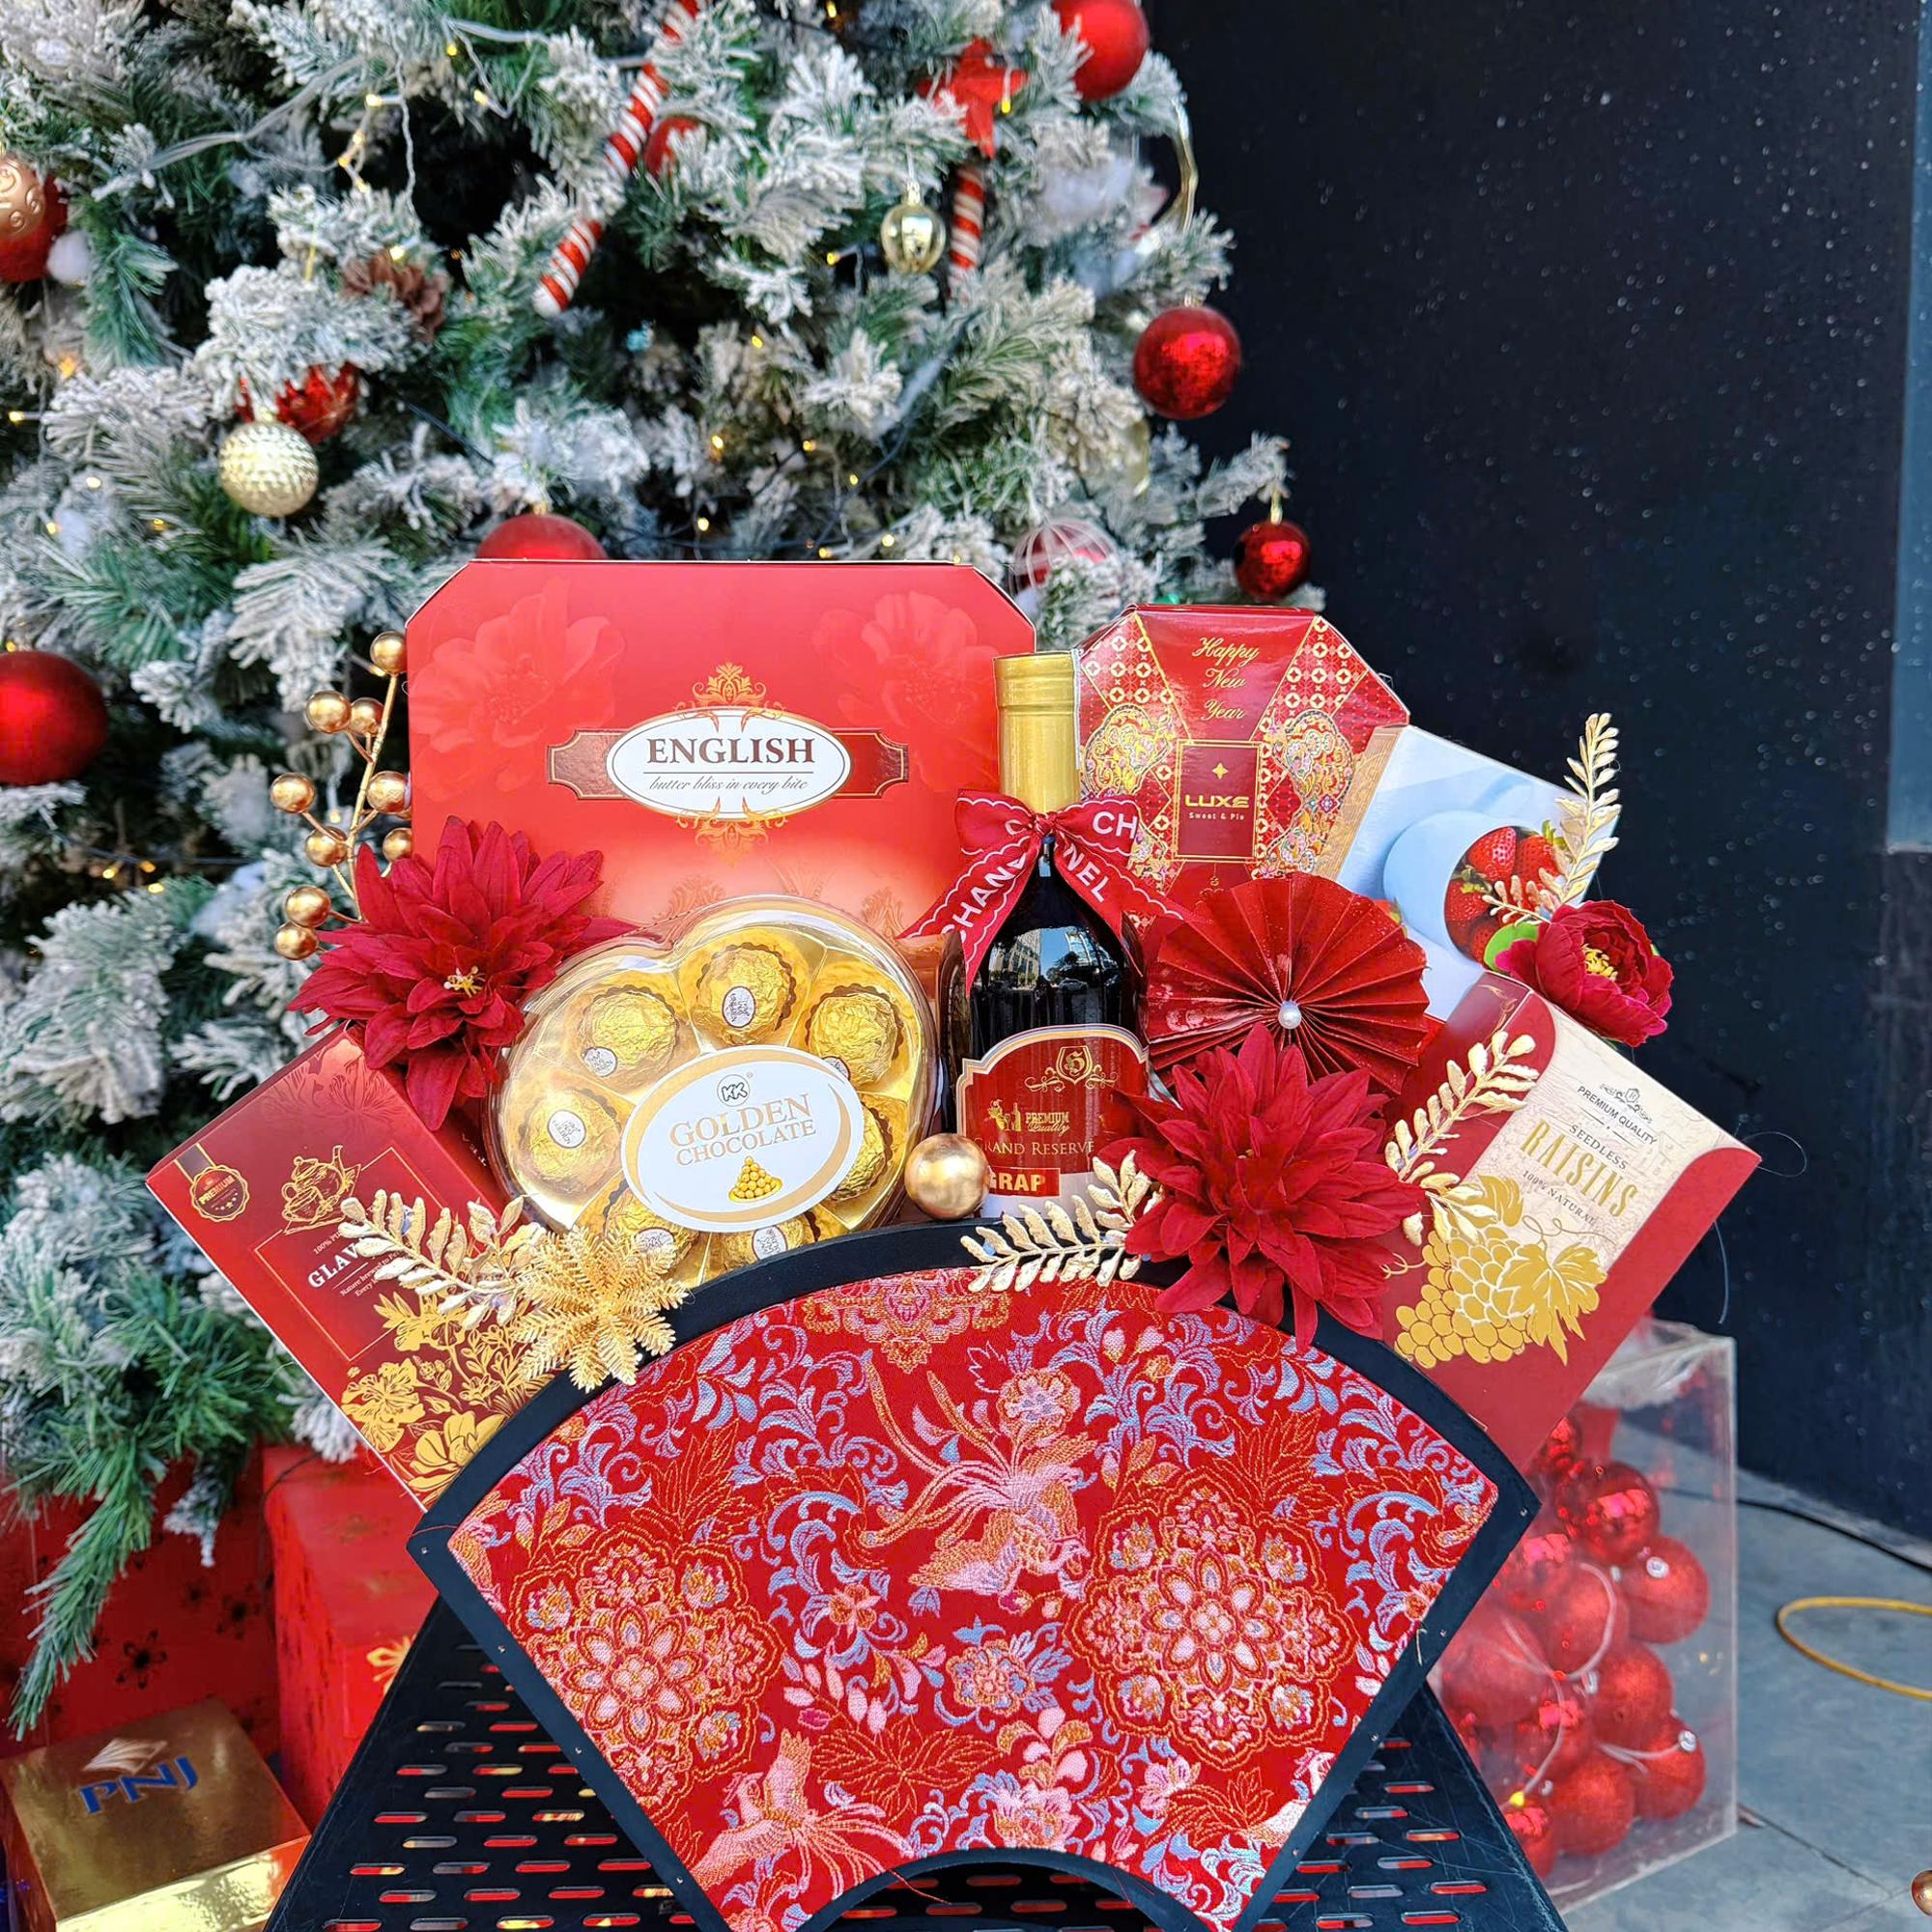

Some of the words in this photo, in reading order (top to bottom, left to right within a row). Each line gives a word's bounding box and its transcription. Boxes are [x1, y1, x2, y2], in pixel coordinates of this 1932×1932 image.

[1192, 638, 1260, 667] Happy
[1203, 668, 1246, 689] New
[1201, 699, 1246, 721] Year
[646, 738, 816, 764] ENGLISH
[649, 776, 691, 790] butter
[693, 776, 724, 790] bliss
[725, 778, 741, 790] in
[743, 780, 779, 796] every
[781, 775, 809, 790] bite
[1184, 794, 1249, 809] LUXE
[721, 1081, 748, 1102] KK
[669, 1094, 812, 1148] GOLDEN
[1025, 1112, 1069, 1123] PREMIUM
[1028, 1121, 1070, 1137] Quality
[1577, 1085, 1619, 1120] PREMIUM
[1618, 1115, 1658, 1146] QUALITY
[675, 1119, 816, 1167] CHOCOLATE
[1569, 1124, 1629, 1170] SEEDLESS
[1520, 1118, 1639, 1217] RAISINS
[198, 1175, 236, 1205] PREMIUM
[1522, 1171, 1548, 1190] 100%
[1548, 1188, 1597, 1226] NATURAL
[340, 1279, 361, 1296] Nature
[79, 1757, 198, 1814] PNJ
